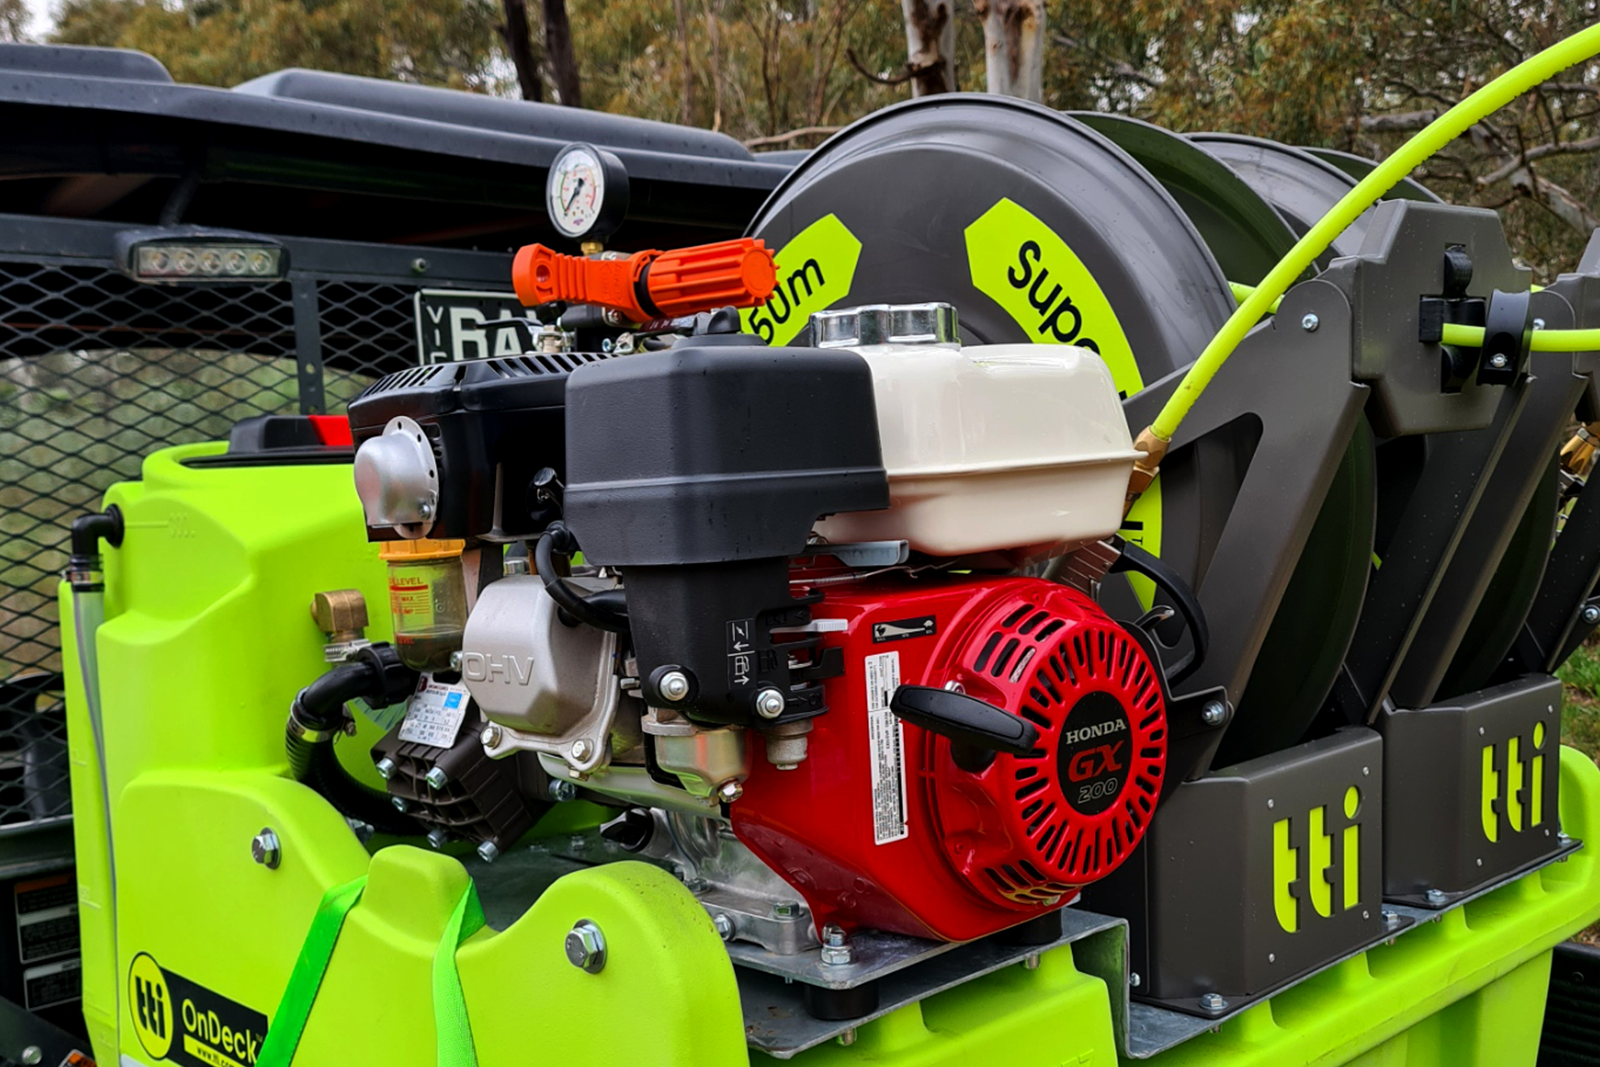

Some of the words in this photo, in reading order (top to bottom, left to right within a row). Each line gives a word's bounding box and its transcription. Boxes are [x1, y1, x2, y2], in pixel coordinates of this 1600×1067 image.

[748, 258, 826, 346] 50m
[449, 307, 538, 361] RA
[463, 651, 534, 686] OHV
[1065, 718, 1127, 745] HONDA
[1068, 740, 1124, 783] GX
[1481, 720, 1545, 844] tti
[1077, 777, 1119, 804] 200
[1272, 784, 1362, 934] tti
[134, 974, 166, 1041] tti
